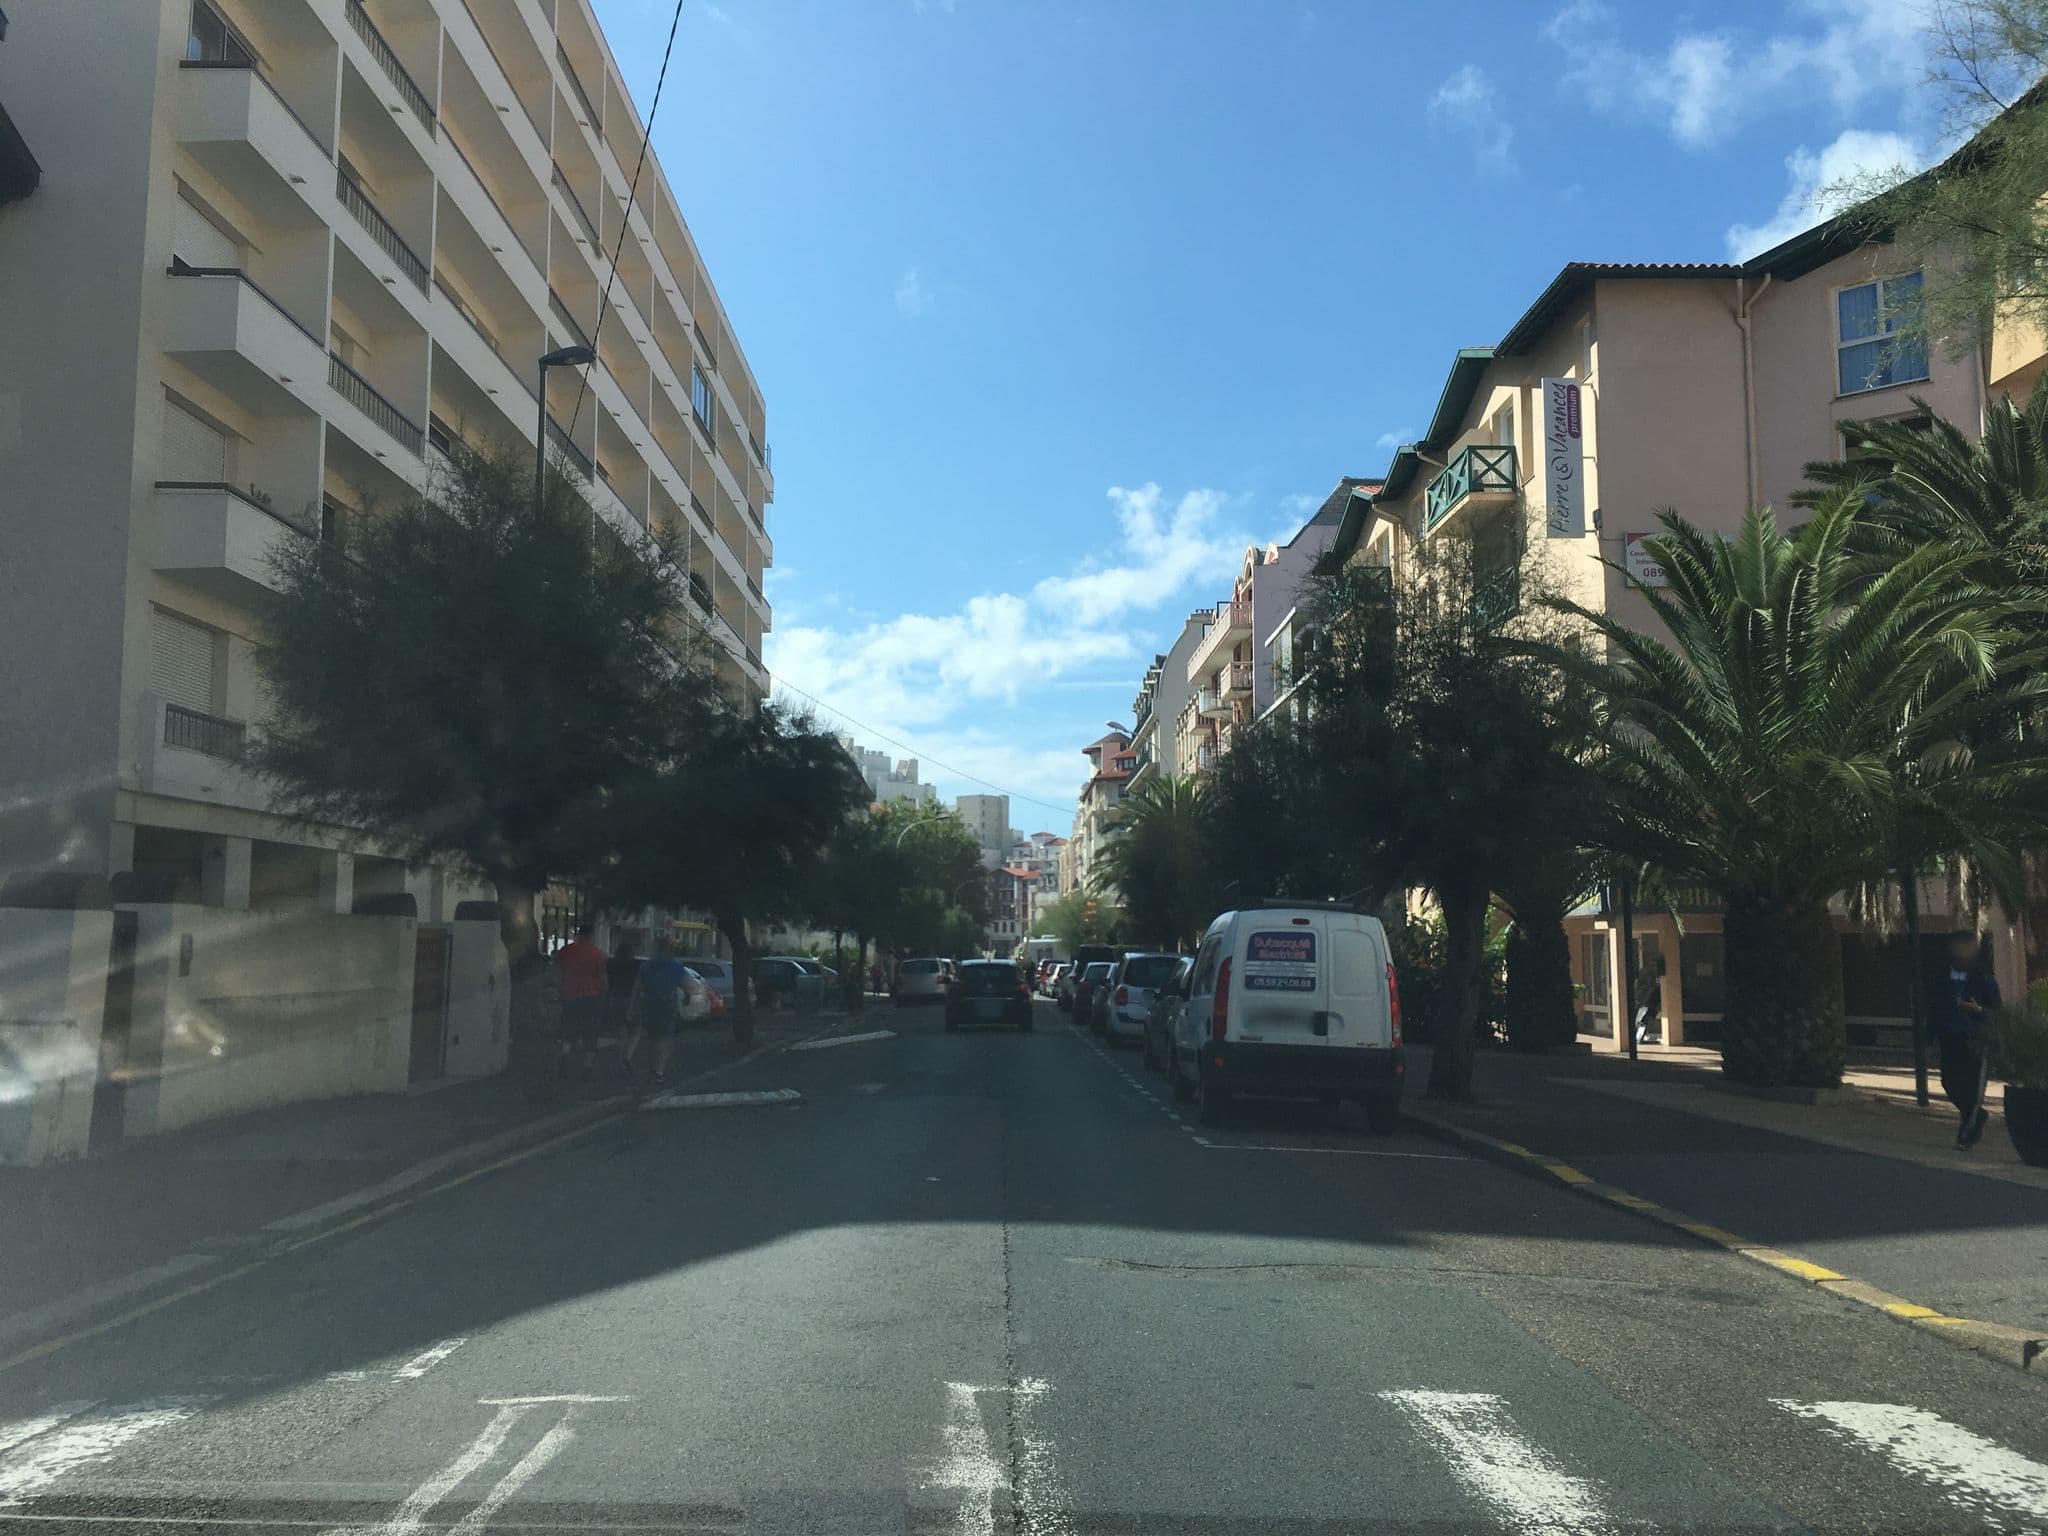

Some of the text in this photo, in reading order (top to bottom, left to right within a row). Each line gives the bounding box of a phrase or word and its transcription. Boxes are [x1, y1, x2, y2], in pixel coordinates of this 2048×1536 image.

[1547, 382, 1569, 453] Vacances
[1550, 484, 1570, 533] Pierre
[1643, 567, 1665, 577] 089
